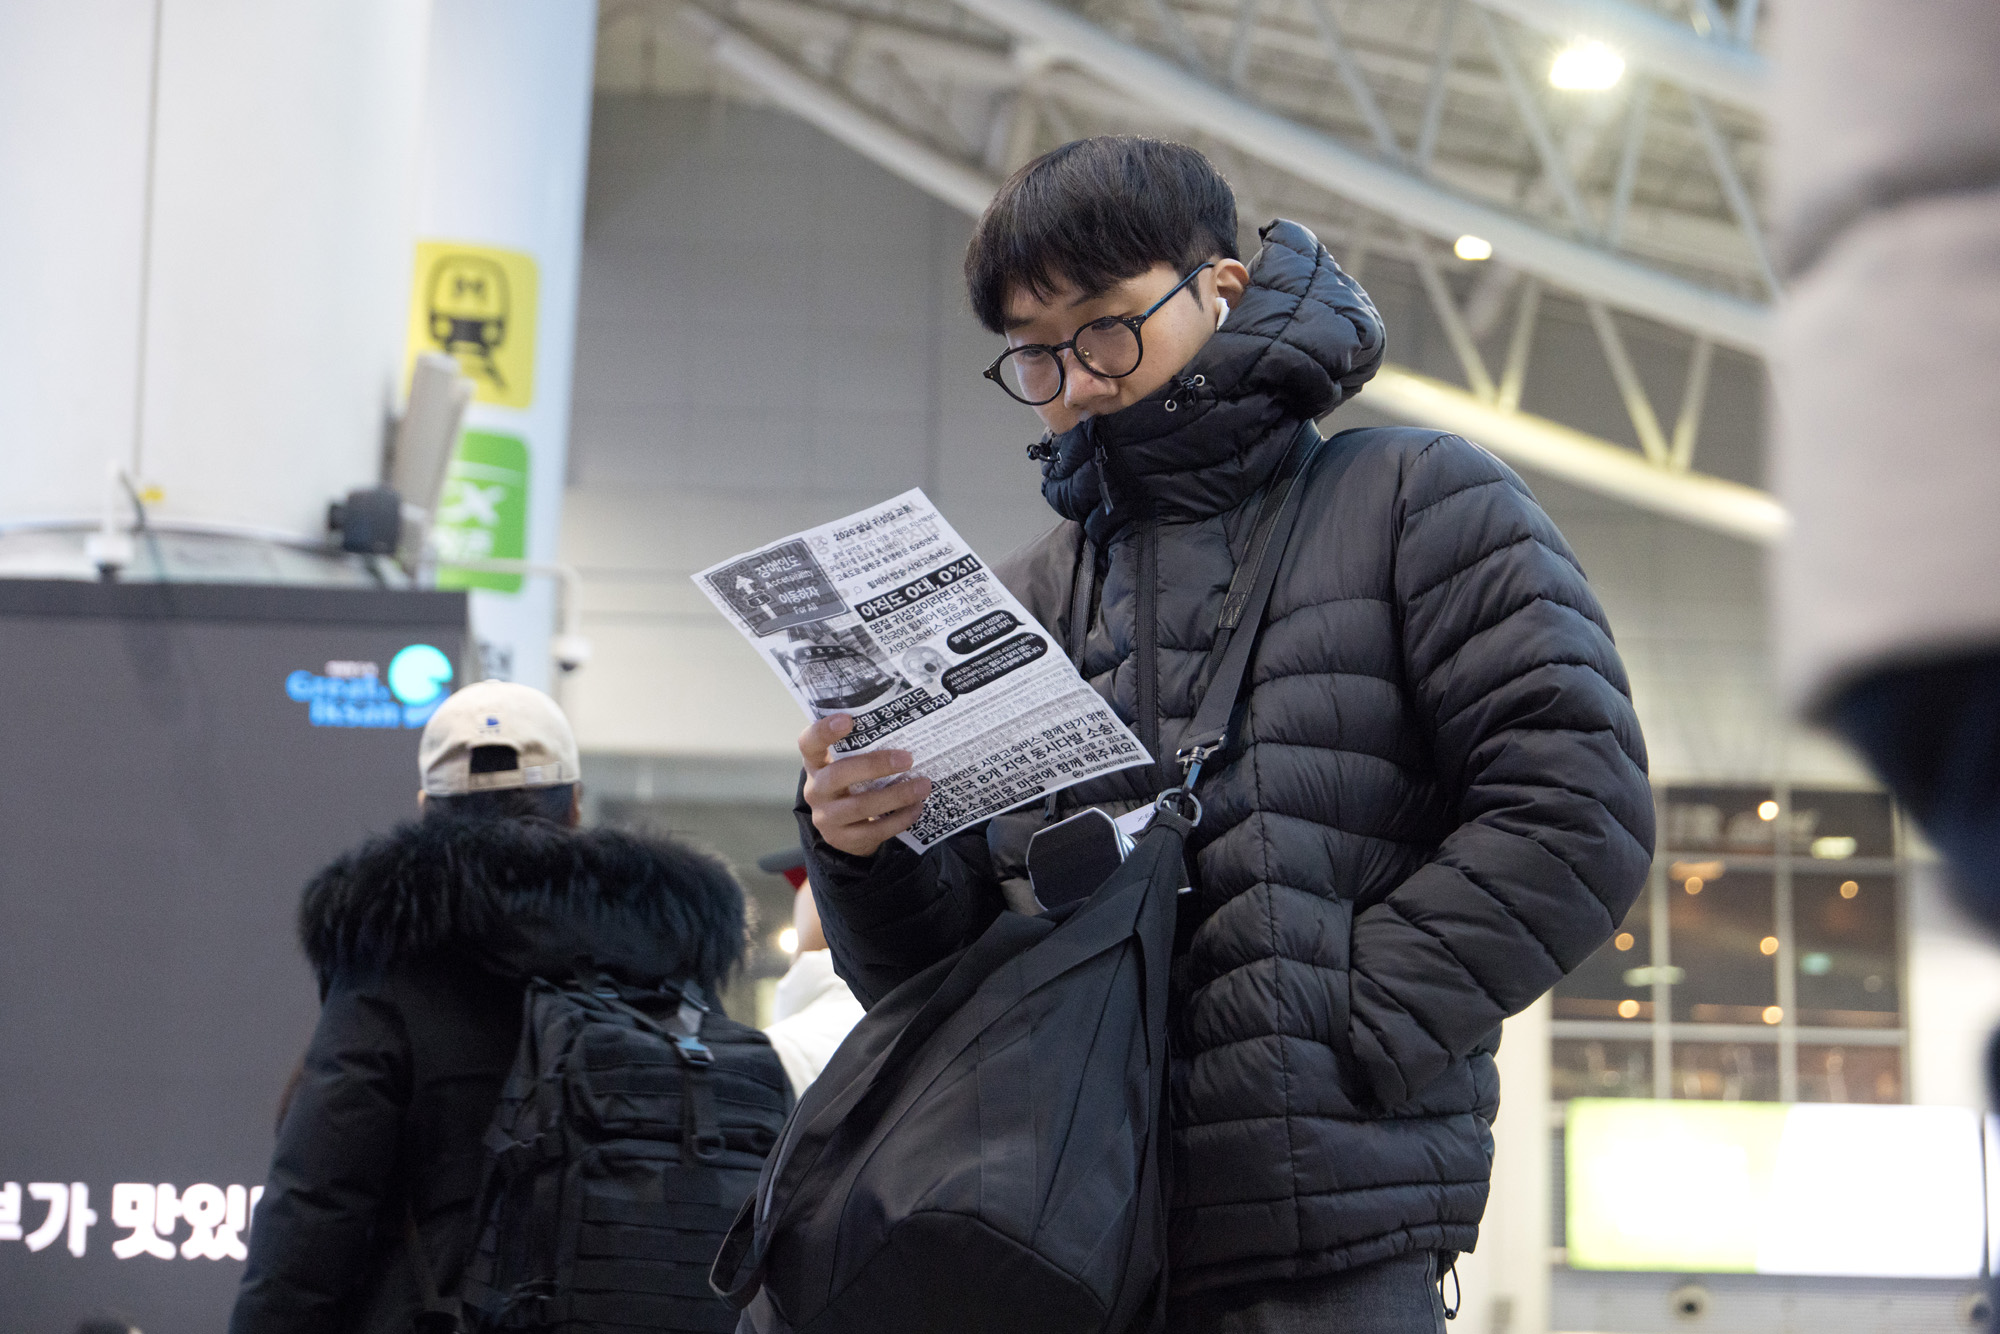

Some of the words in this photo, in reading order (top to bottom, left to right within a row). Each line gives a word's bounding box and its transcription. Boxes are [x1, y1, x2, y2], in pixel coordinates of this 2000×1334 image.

[831, 526, 858, 542] 2026
[863, 539, 877, 549] 기간
[753, 552, 803, 580] 장애인도
[762, 568, 817, 591] Accessibility
[859, 590, 908, 620] 아직도
[902, 575, 941, 601] 0대,
[936, 556, 980, 584] 0%!!
[866, 573, 892, 590] 휠체어
[888, 566, 909, 581] 탑승
[907, 547, 953, 572] 시외고속버스
[776, 586, 823, 606] 이동하자
[791, 604, 809, 614] For
[804, 602, 820, 612] All
[868, 617, 894, 635] 명절
[891, 589, 953, 625] 귀성길이라면
[950, 583, 966, 595] 더
[962, 572, 989, 588] 주목!
[880, 626, 910, 645] 전국에
[906, 612, 939, 632] 휠체어
[938, 601, 960, 618] 탑승
[956, 586, 989, 607] 가능한
[889, 624, 943, 654] 시외고속버스
[943, 606, 975, 627] 전무해
[949, 631, 968, 645] 열차
[967, 631, 987, 645] KTX
[982, 624, 1000, 637] 타면
[849, 707, 923, 750] 시외고속버스를
[920, 694, 951, 714] 타자!
[852, 711, 882, 733] 정말!
[878, 687, 930, 720] 장애인도
[938, 763, 981, 788] 장애인도
[981, 737, 1043, 768] 시외고속버스
[1040, 724, 1067, 742] 함께
[1063, 716, 1087, 730] 타기
[1087, 708, 1110, 725] 위한
[947, 779, 978, 797] 전국
[976, 767, 1003, 784] 8개
[1000, 753, 1032, 772] 지역
[1030, 731, 1084, 760] 동시다발
[1087, 722, 1117, 739] 소송!
[996, 768, 1031, 787] 장애인도
[1027, 757, 1058, 773] 고속버스
[1057, 750, 1075, 760] 타고
[1076, 742, 1098, 754] 귀성할
[1097, 739, 1106, 747] 수
[968, 785, 1016, 812] 소송비용
[1016, 767, 1057, 789] 마련에
[1054, 756, 1086, 775] 함께
[1082, 741, 1140, 764] 해주세요!
[112, 1179, 264, 1261] 맛있
